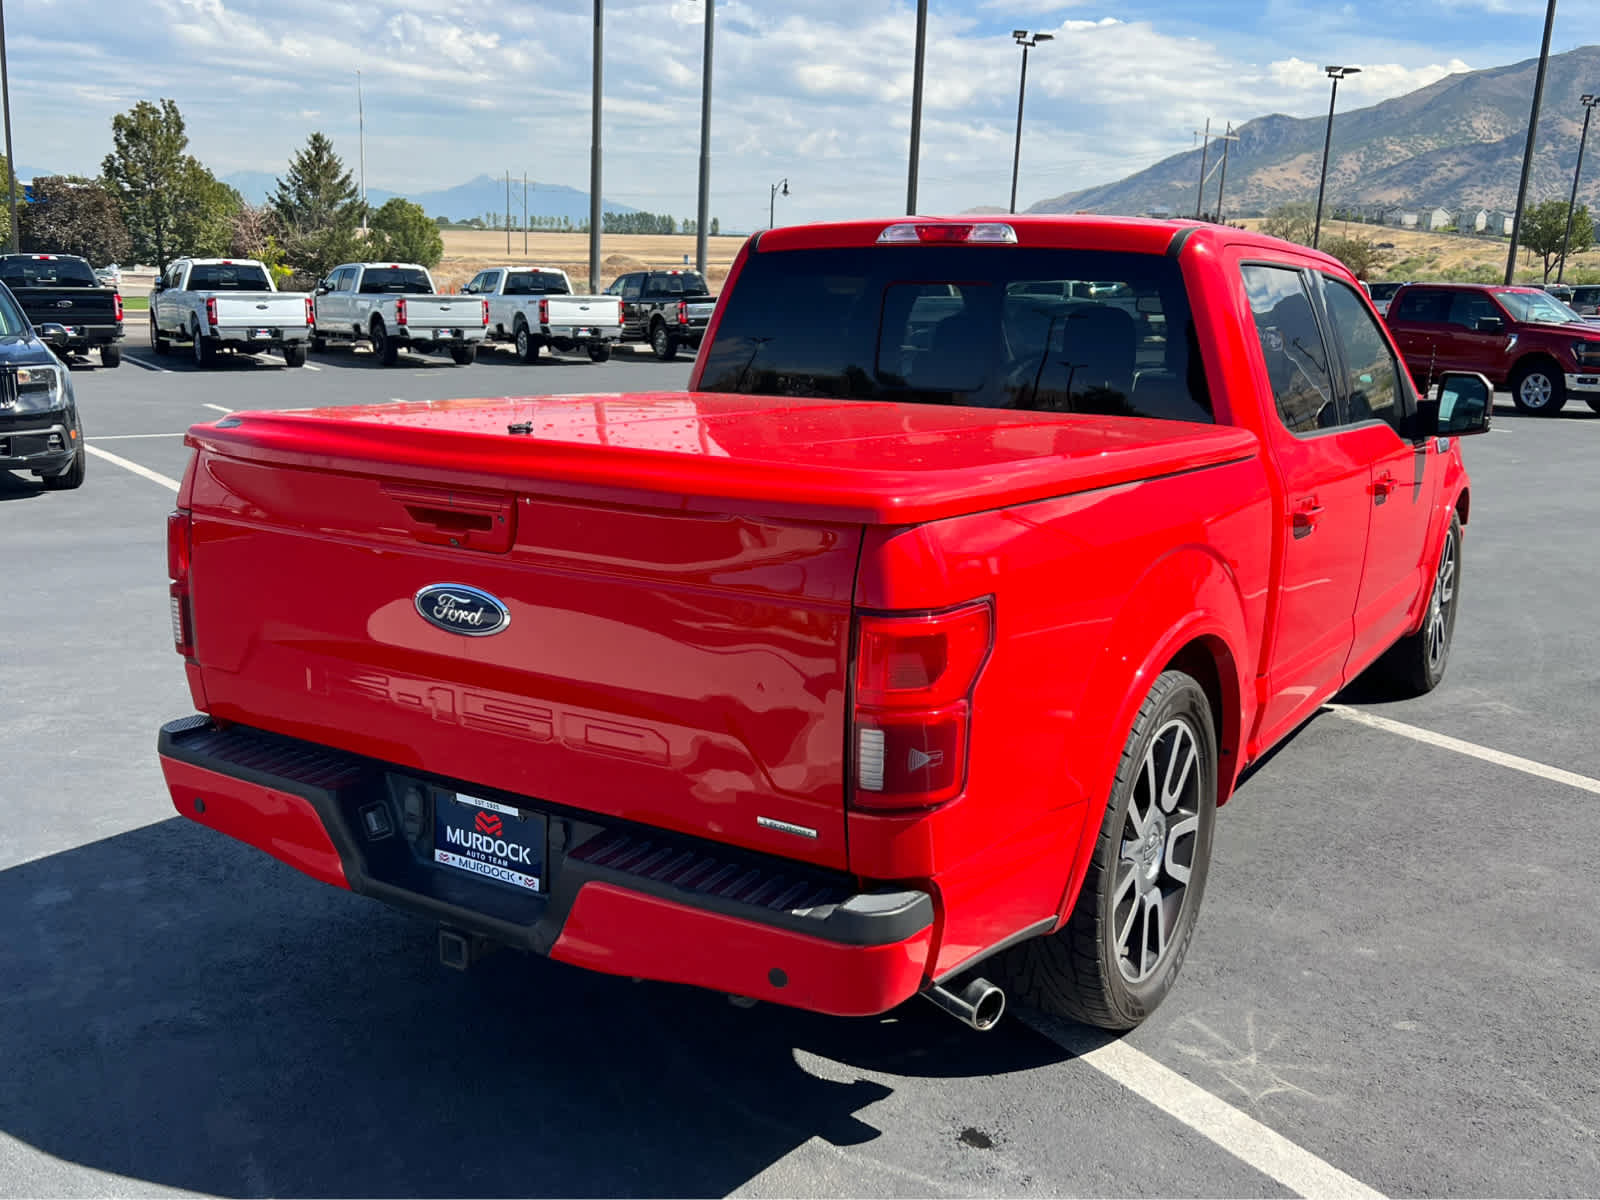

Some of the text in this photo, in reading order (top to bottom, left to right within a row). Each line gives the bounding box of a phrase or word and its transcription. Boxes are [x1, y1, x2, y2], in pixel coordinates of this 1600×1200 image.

[433, 593, 484, 626] Ford
[446, 825, 531, 865] MURDOCK
[466, 850, 508, 867] AUTO TEAM
[458, 857, 515, 882] MURDOCK
